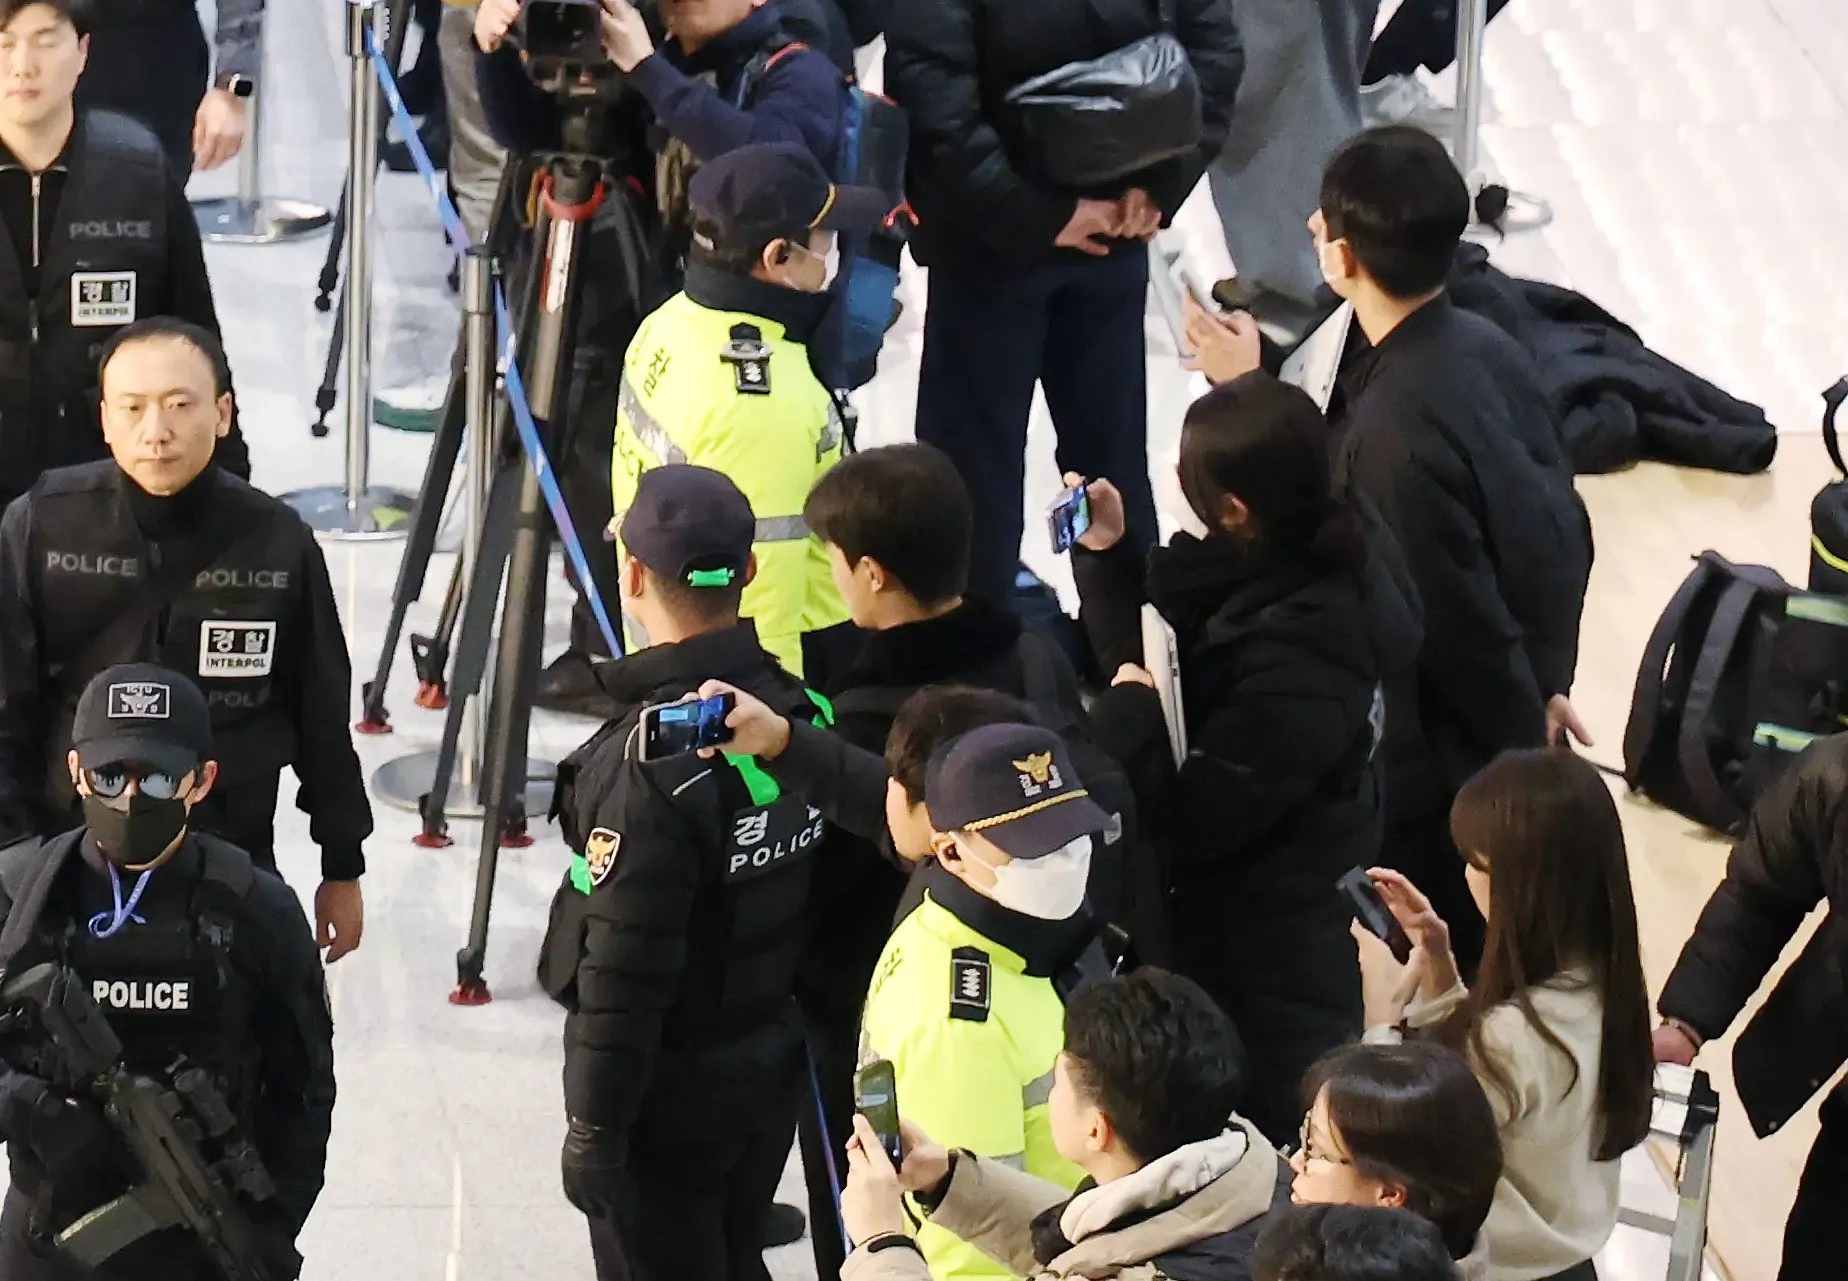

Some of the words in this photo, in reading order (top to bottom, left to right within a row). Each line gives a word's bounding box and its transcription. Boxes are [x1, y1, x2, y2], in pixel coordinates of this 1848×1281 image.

[69, 220, 151, 239] POLICE
[47, 551, 137, 576] POLICE
[196, 569, 289, 589] POLICE
[207, 657, 266, 668] INTERPOL
[729, 820, 823, 873] POLICE
[92, 980, 189, 1009] POLICE
